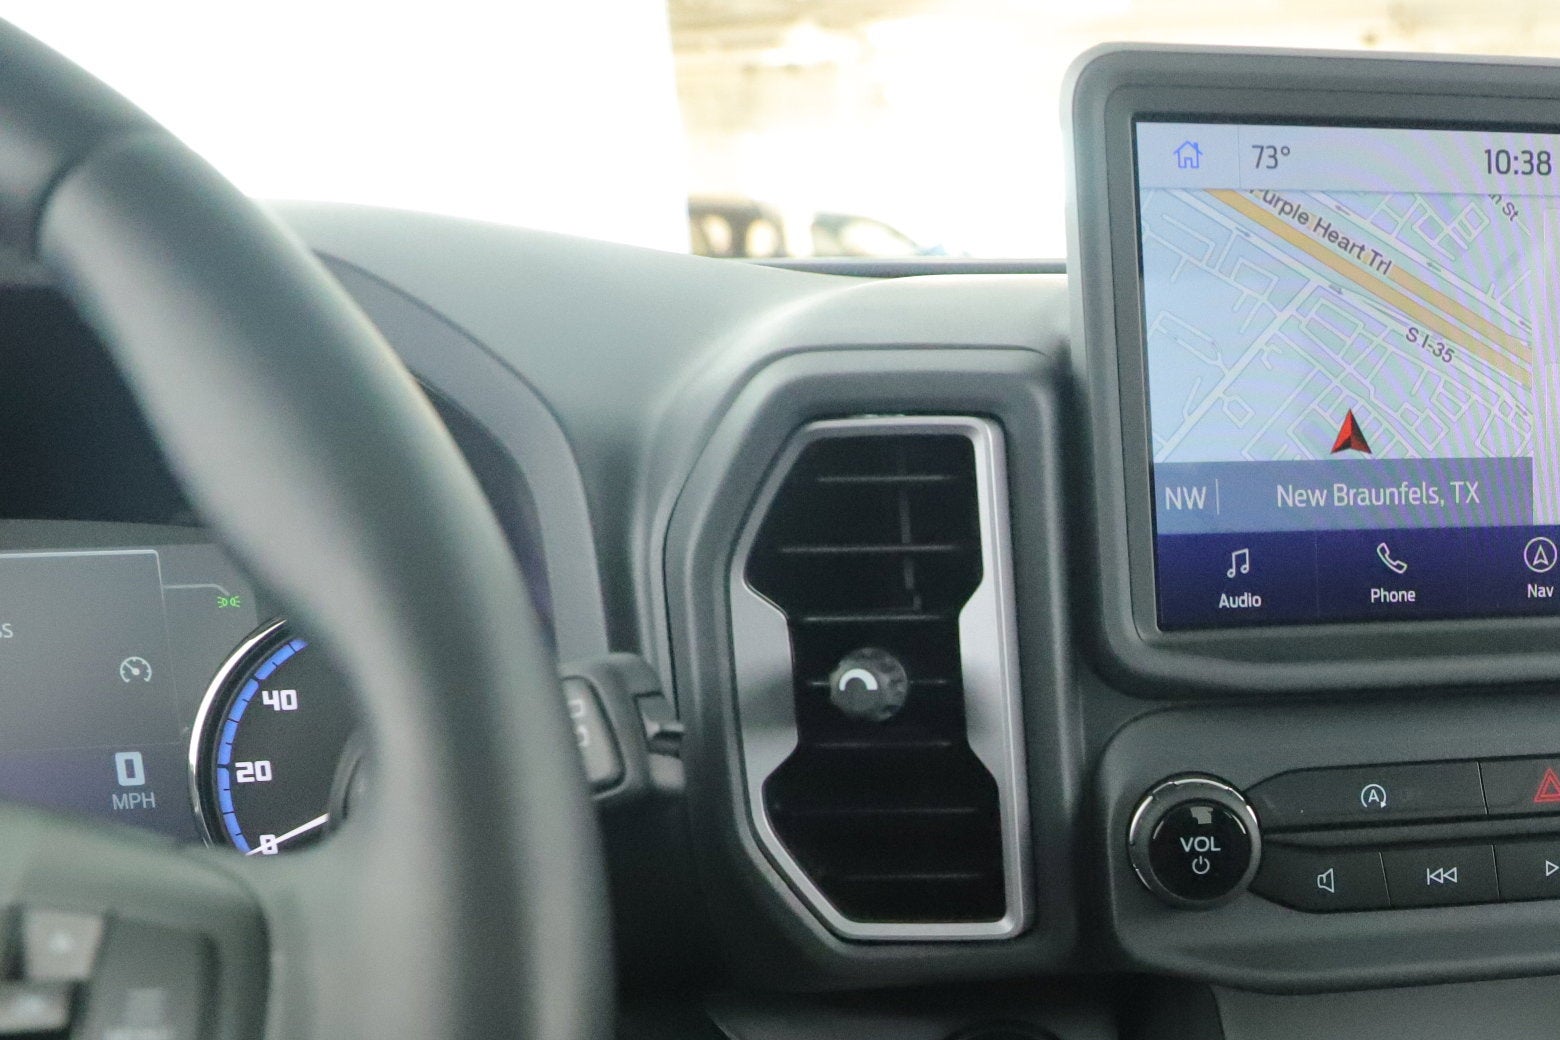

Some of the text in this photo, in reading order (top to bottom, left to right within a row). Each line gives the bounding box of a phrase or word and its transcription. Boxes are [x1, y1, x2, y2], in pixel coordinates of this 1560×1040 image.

[1484, 148, 1552, 175] 10:38
[1502, 201, 1519, 223] St
[1250, 189, 1393, 276] urple Heart Trl
[1405, 326, 1456, 364] S I-35
[1165, 486, 1207, 511] NW
[1276, 480, 1481, 508] New Braunfels, TX
[1218, 593, 1262, 609] Audio
[1370, 587, 1416, 604] Phone
[1527, 583, 1555, 598] Nav
[262, 689, 298, 711] 40
[114, 751, 146, 787] 0
[235, 760, 273, 783] 20
[111, 791, 156, 811] MPH
[1179, 835, 1221, 853] VOL
